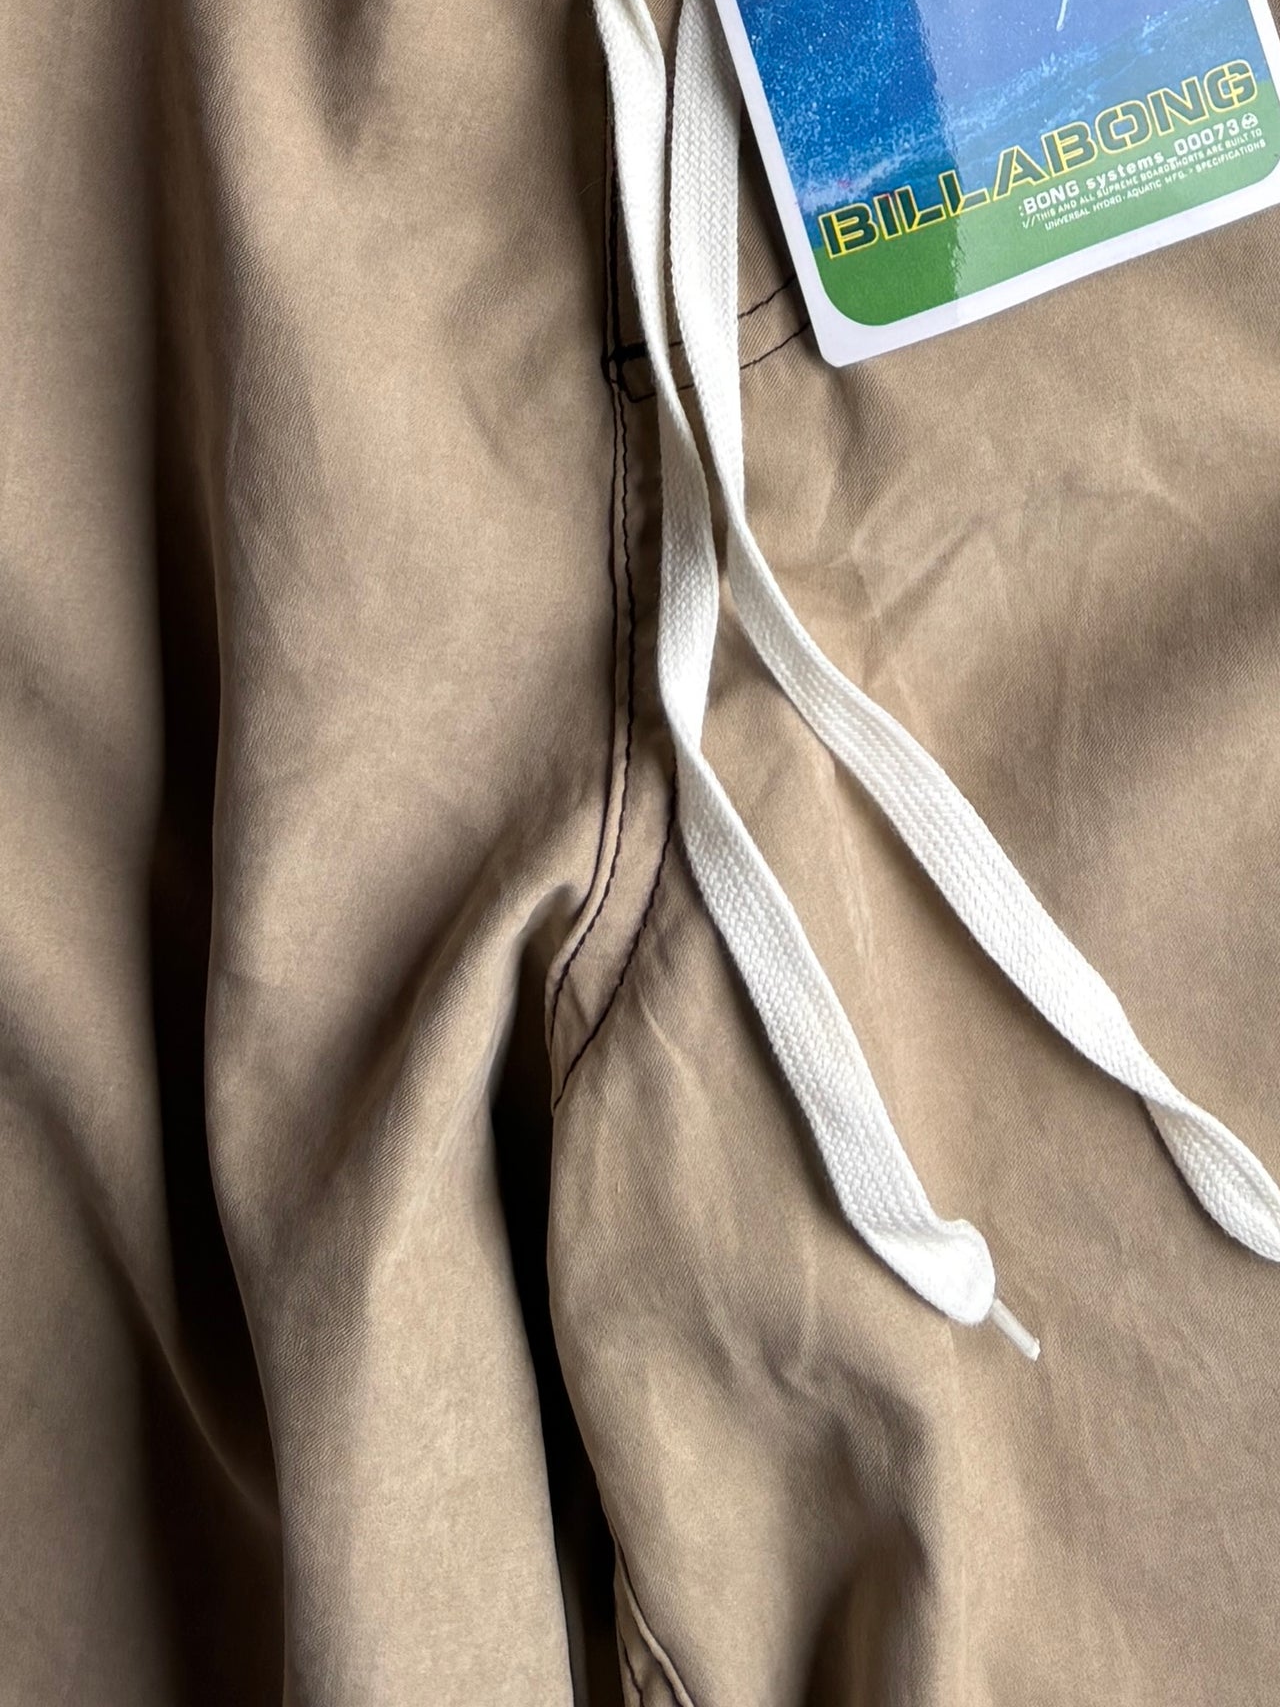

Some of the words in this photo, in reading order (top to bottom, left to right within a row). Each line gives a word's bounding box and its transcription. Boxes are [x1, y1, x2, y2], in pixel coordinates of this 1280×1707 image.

[818, 58, 1258, 260] BILLABONG
[1044, 208, 1091, 231] UNIVERSAL
[1195, 139, 1266, 173] SPECIFICATIONS
[1058, 200, 1077, 214] AND
[1080, 195, 1095, 206] ALL
[1096, 175, 1138, 199] SUPREME
[1206, 144, 1224, 156] ARE
